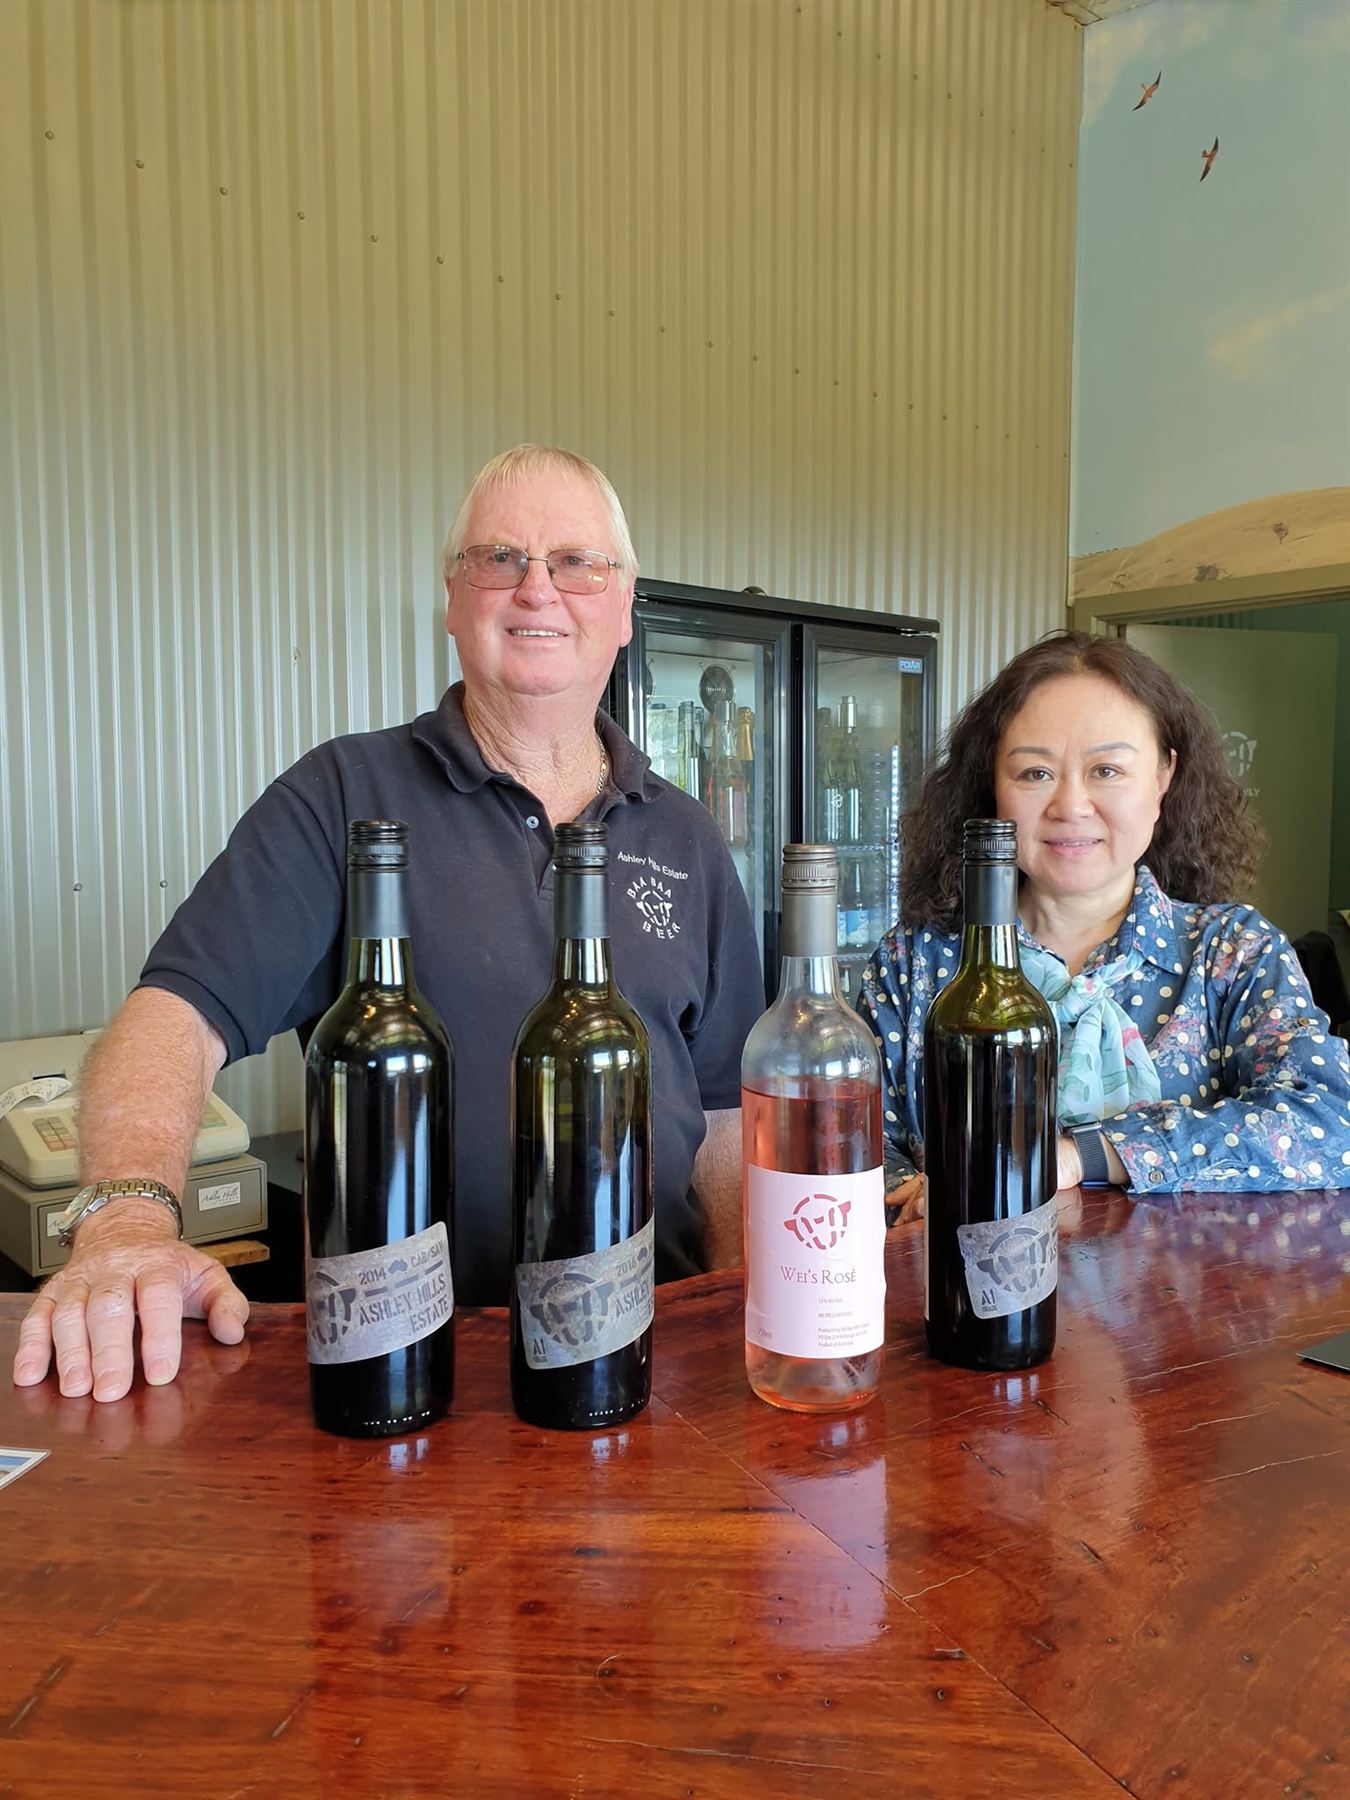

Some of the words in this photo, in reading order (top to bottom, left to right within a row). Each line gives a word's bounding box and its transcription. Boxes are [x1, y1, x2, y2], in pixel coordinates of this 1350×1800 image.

[617, 851, 647, 865] Ashley
[662, 866, 689, 880] Estate
[626, 876, 647, 900] BAA
[650, 876, 672, 899] BAA
[642, 920, 681, 940] BEER
[358, 1267, 387, 1286] 2014
[780, 1265, 818, 1285] WEI'S
[360, 1292, 413, 1326] ASHLEY
[416, 1272, 446, 1305] HILLS
[410, 1294, 450, 1334] ESTATE
